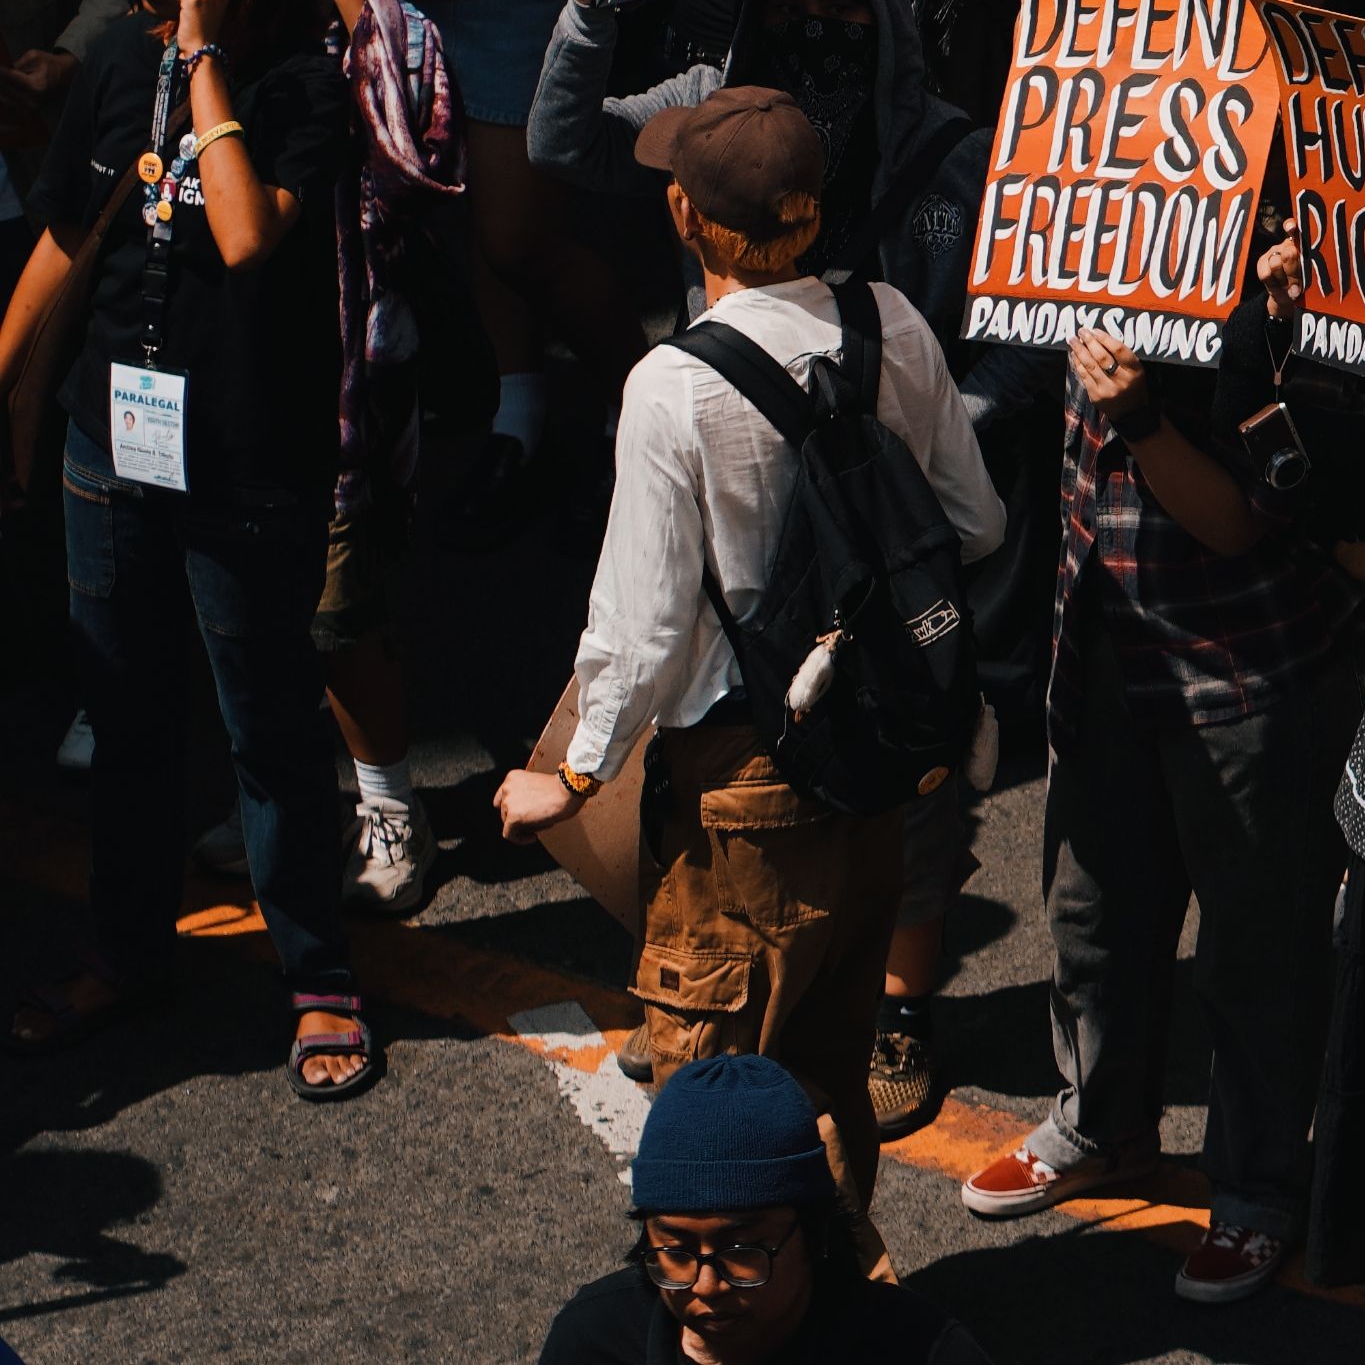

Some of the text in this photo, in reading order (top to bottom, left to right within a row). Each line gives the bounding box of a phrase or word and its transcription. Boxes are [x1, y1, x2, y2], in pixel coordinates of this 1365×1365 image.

[993, 65, 1256, 192] PRESS
[971, 173, 1256, 307] FREEDOM
[966, 297, 1223, 363] PANDAY SINING
[114, 389, 180, 412] PARALEGAL
